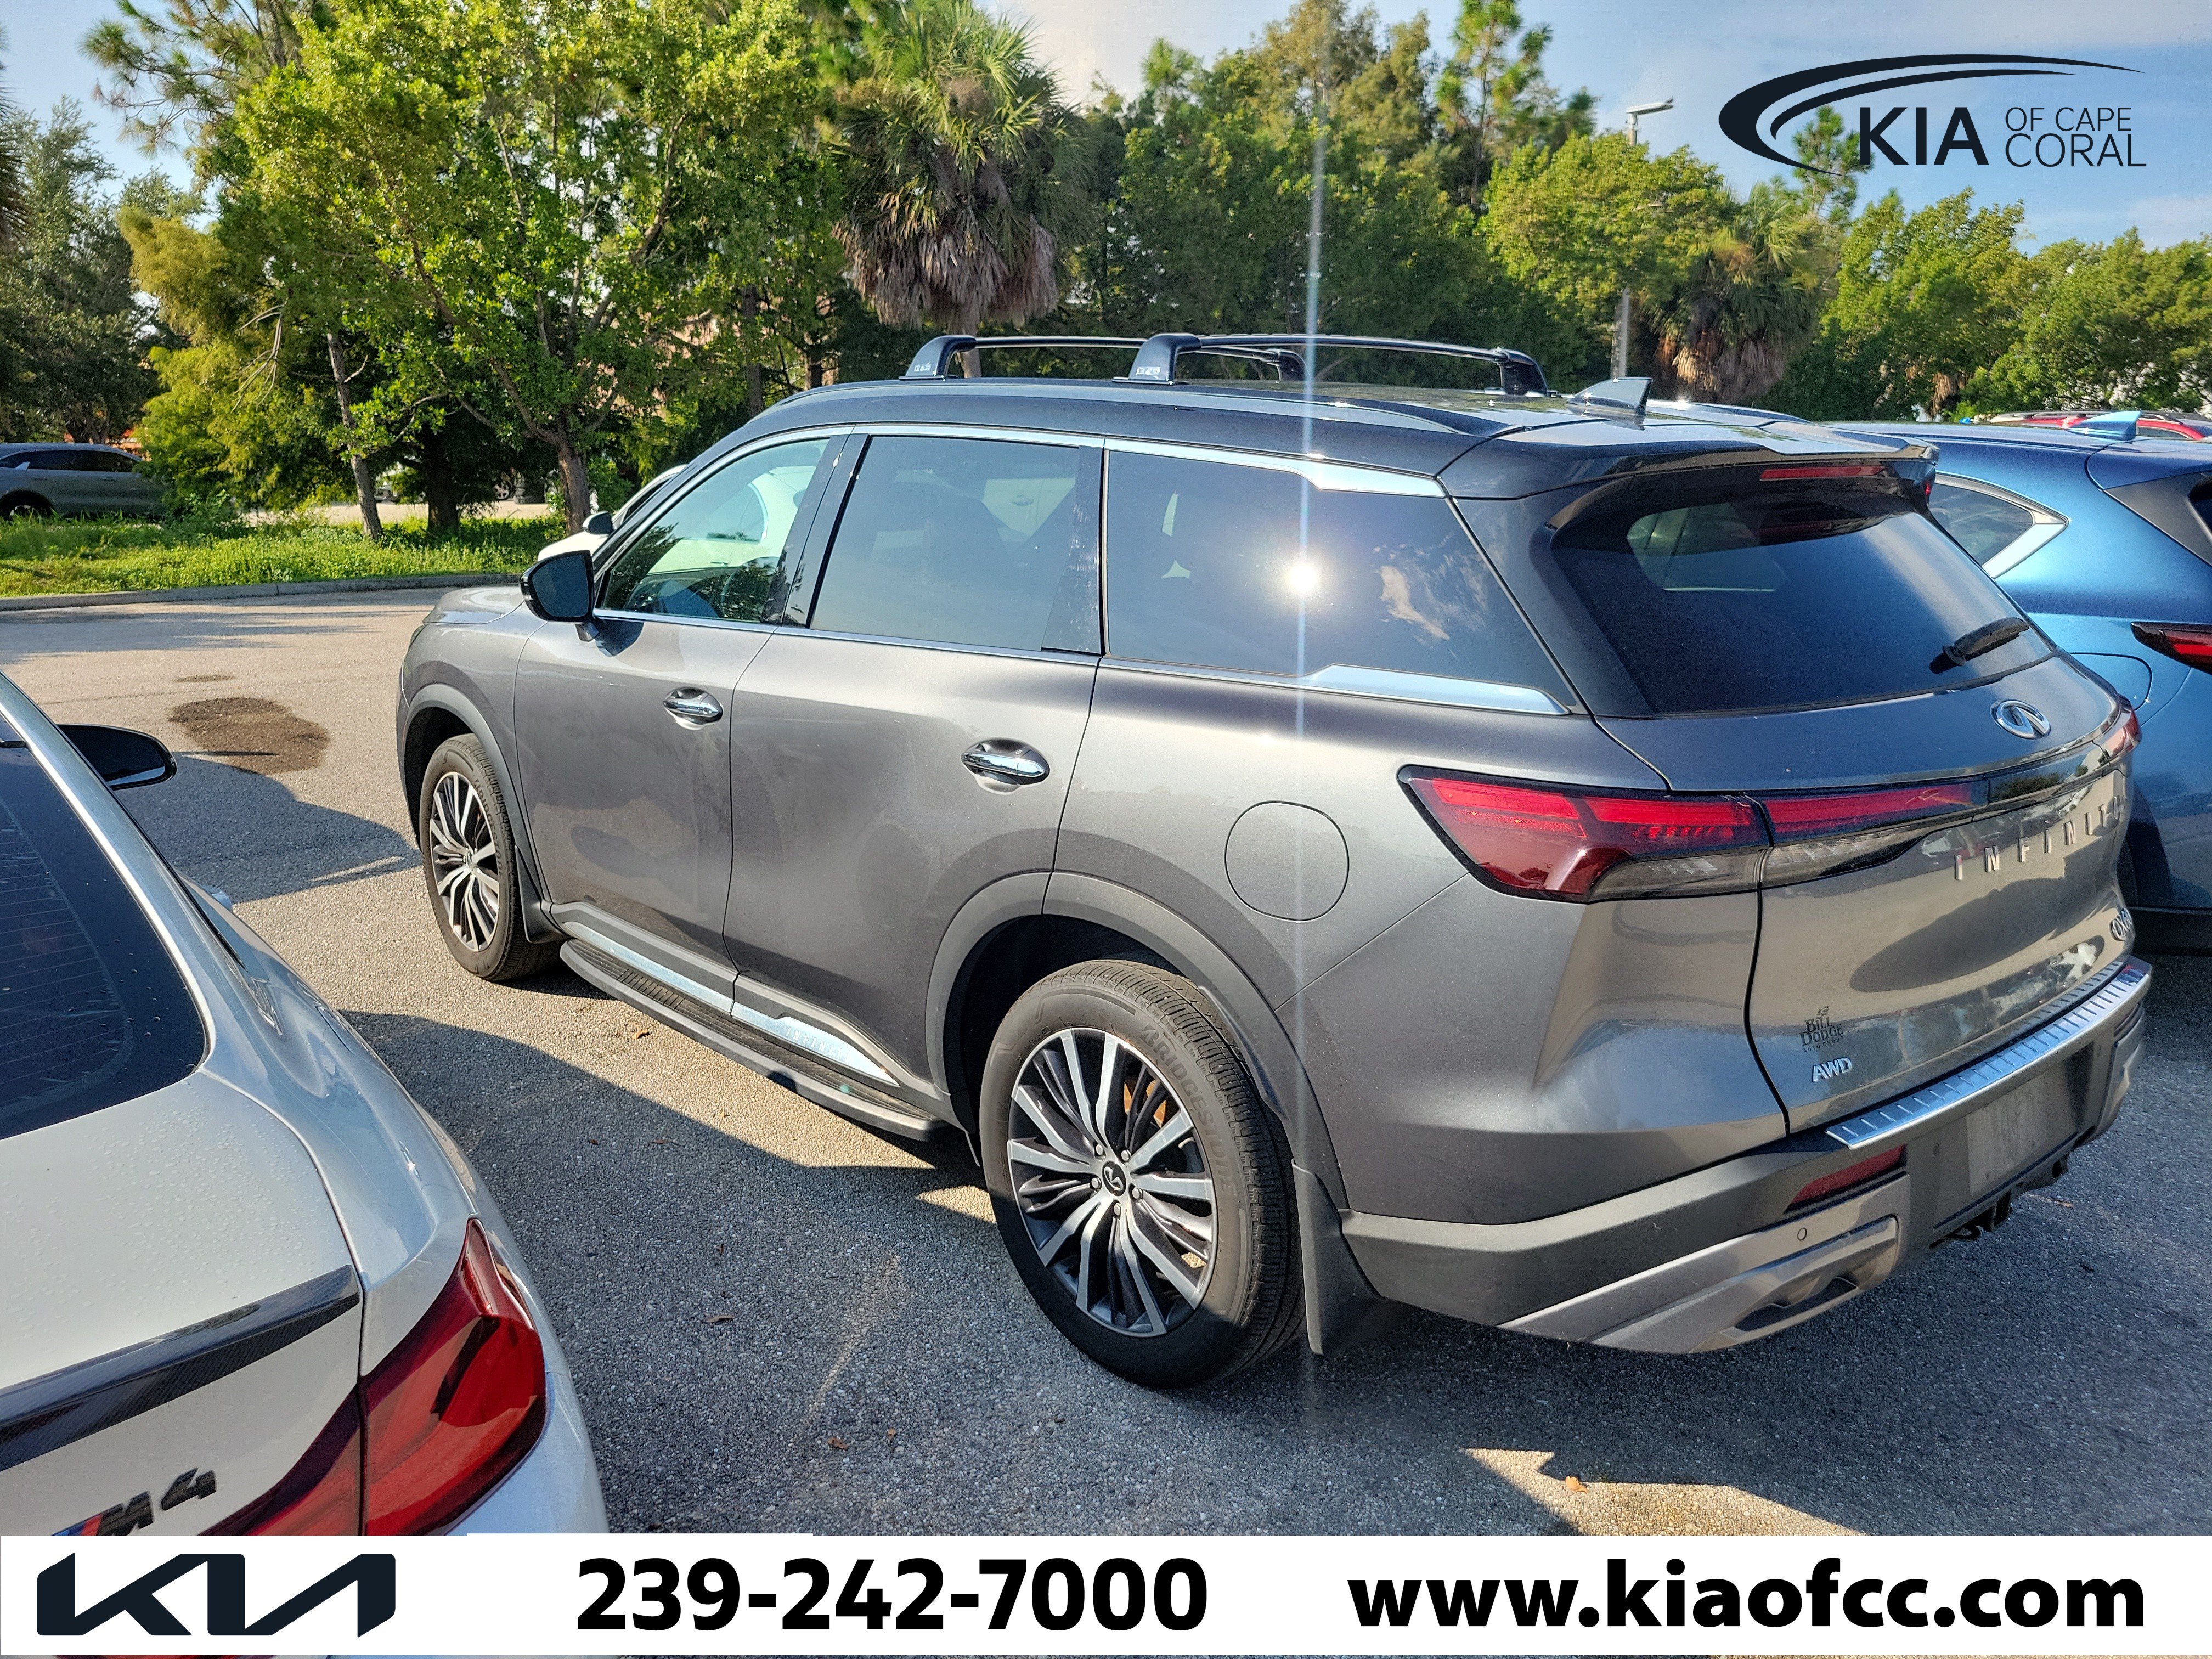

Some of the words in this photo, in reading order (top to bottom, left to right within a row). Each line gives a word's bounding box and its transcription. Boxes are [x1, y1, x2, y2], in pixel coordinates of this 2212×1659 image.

[1799, 1024, 1844, 1046] DODGE
[1803, 1043, 1820, 1053] AUTO
[1812, 1057, 1852, 1082] AWD
[1141, 1024, 1237, 1192] BRIDGESTONE
